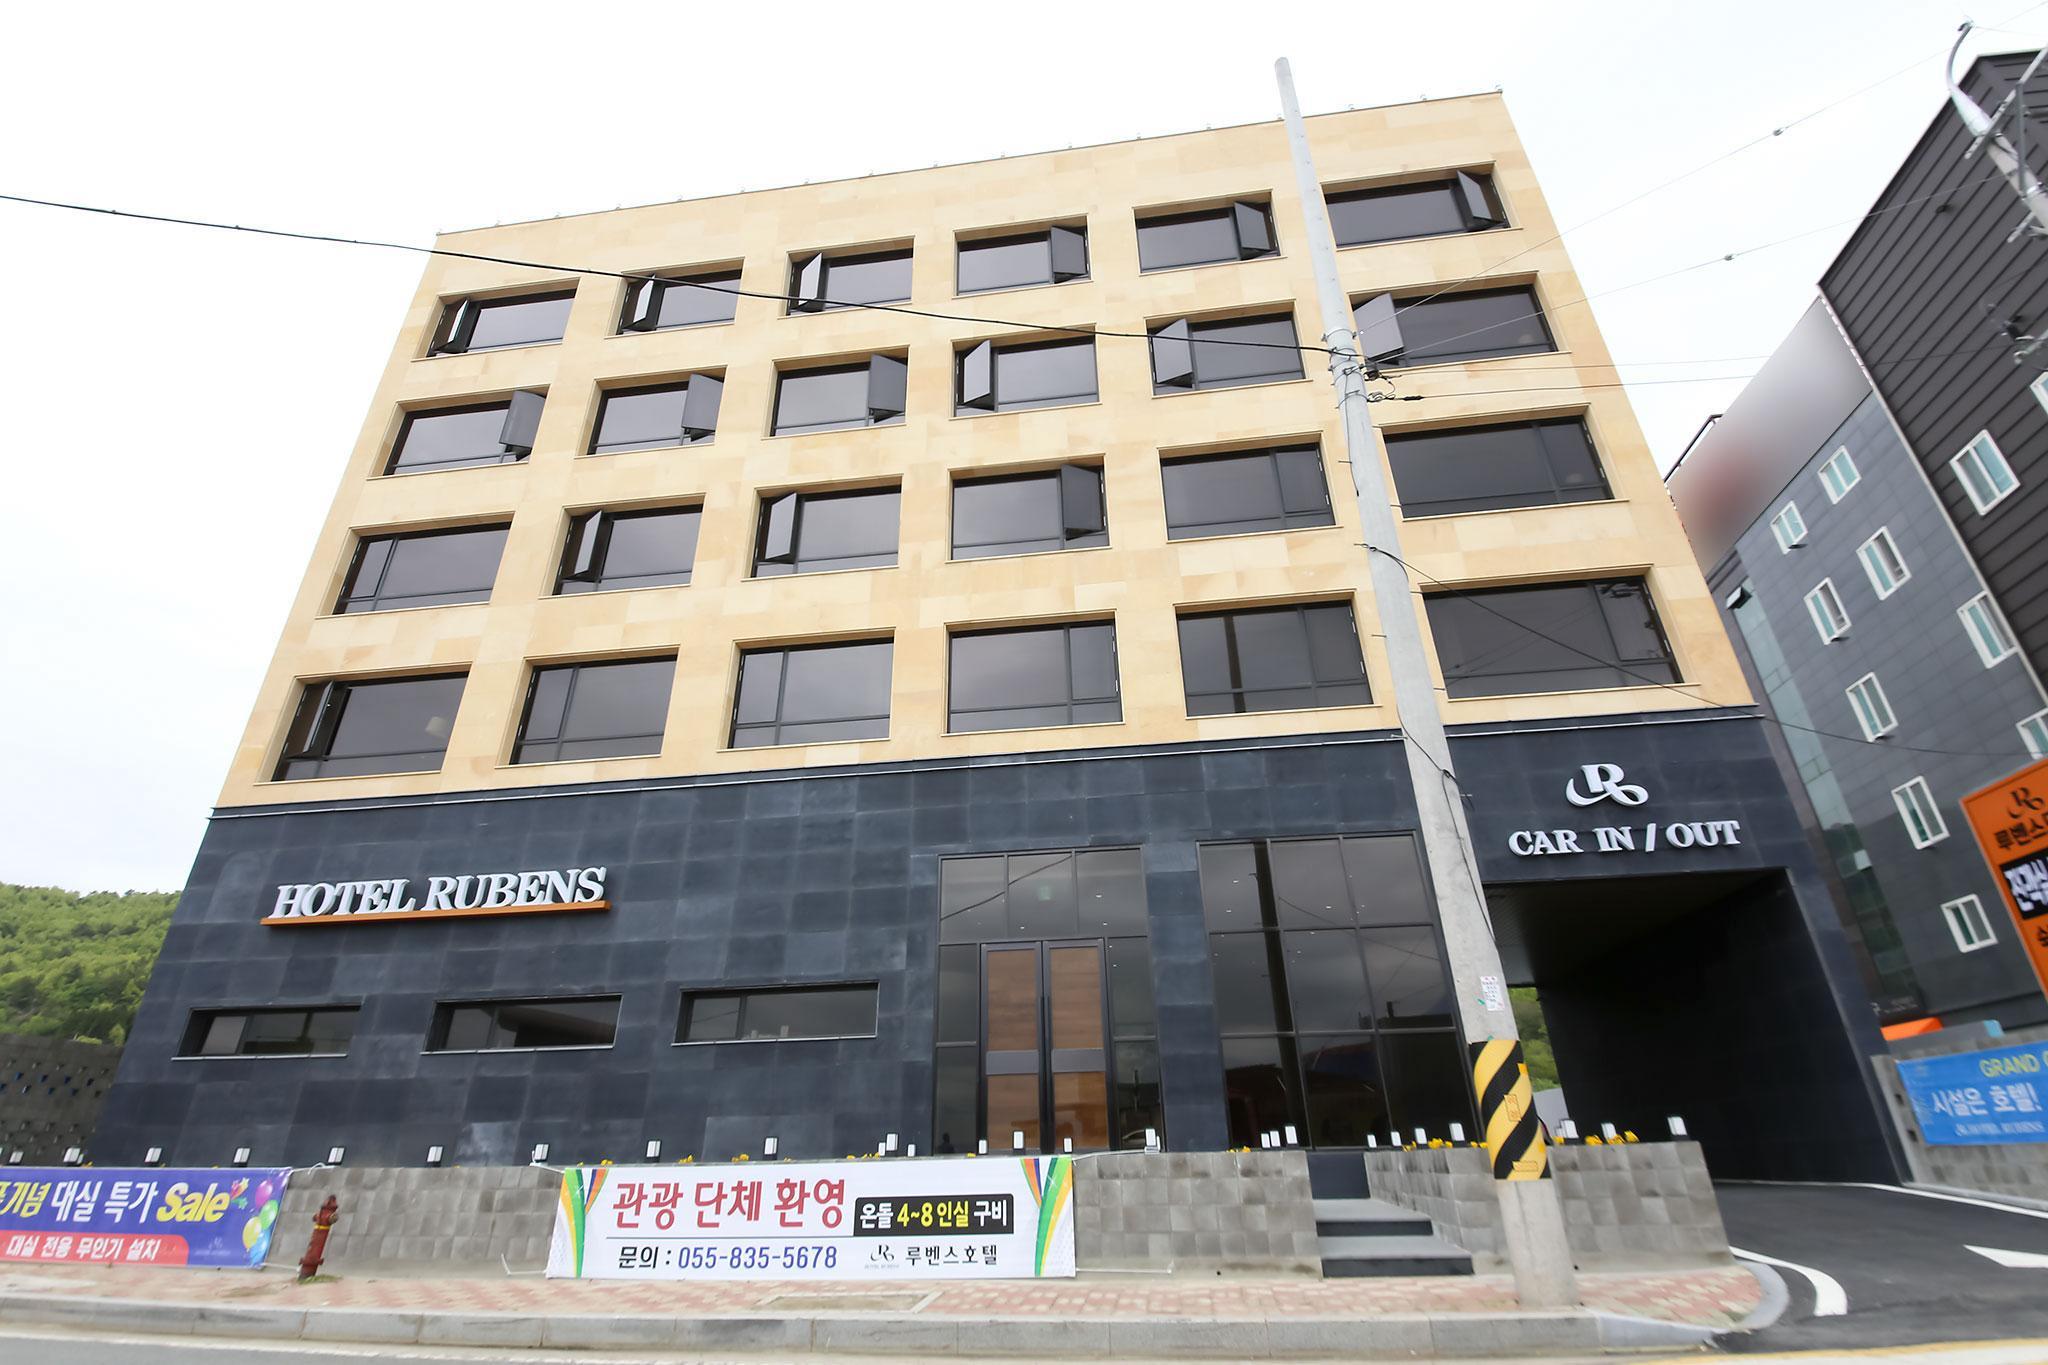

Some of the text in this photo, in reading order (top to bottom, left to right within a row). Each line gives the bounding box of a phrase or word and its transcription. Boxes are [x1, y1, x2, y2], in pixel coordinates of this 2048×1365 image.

[1508, 829, 1584, 856] CAR
[1592, 826, 1635, 852] IN
[1666, 820, 1741, 848] OUT
[268, 867, 607, 919] HOTEL RUBENS
[1979, 1053, 2041, 1078] GRAND
[51, 1180, 103, 1222] 대실
[104, 1180, 159, 1224] 특가
[156, 1182, 230, 1223] Sale
[612, 1178, 845, 1230] 관광 단체 환영
[860, 1202, 894, 1229] 온돌
[973, 1199, 1007, 1227] 구비
[6, 1235, 161, 1261] 대실 전용 무인기 설치
[678, 1245, 838, 1269] 055-835-5678
[905, 1244, 997, 1266] 루벤스호텔
